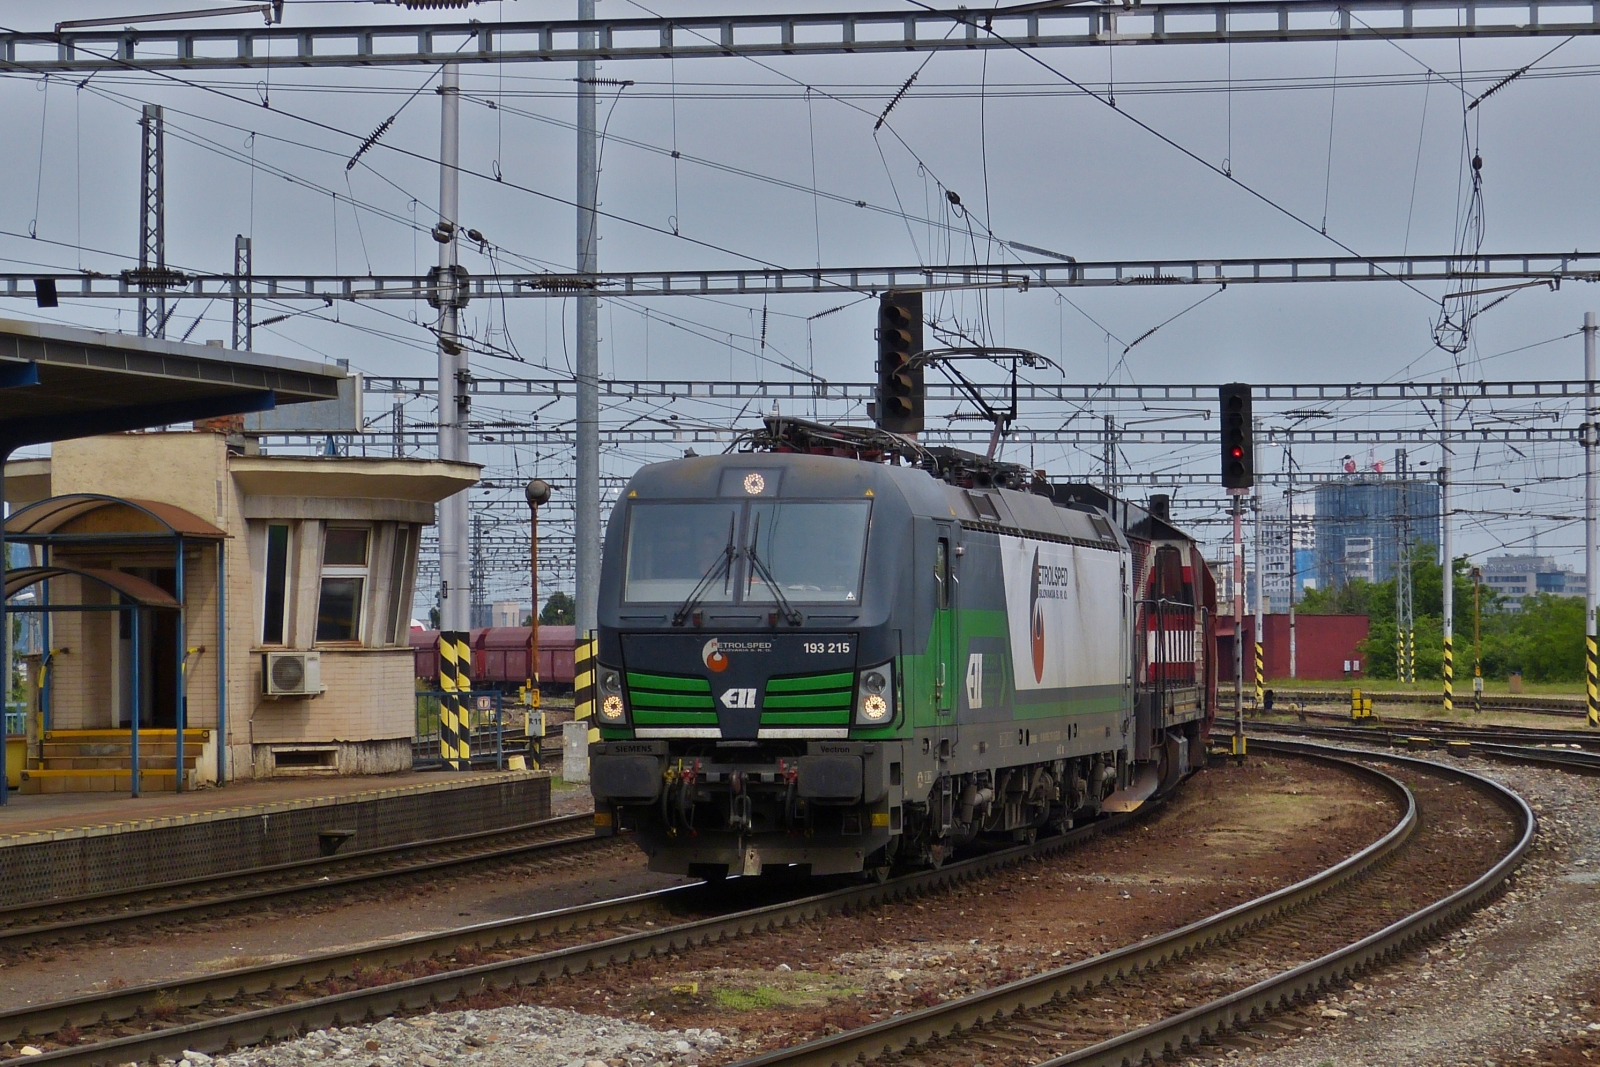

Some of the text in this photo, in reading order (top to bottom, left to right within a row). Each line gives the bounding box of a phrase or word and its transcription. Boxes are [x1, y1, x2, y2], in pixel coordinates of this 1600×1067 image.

[804, 642, 850, 653] 193 215
[615, 745, 652, 753] SIEMENS
[820, 745, 850, 753] Vectron
